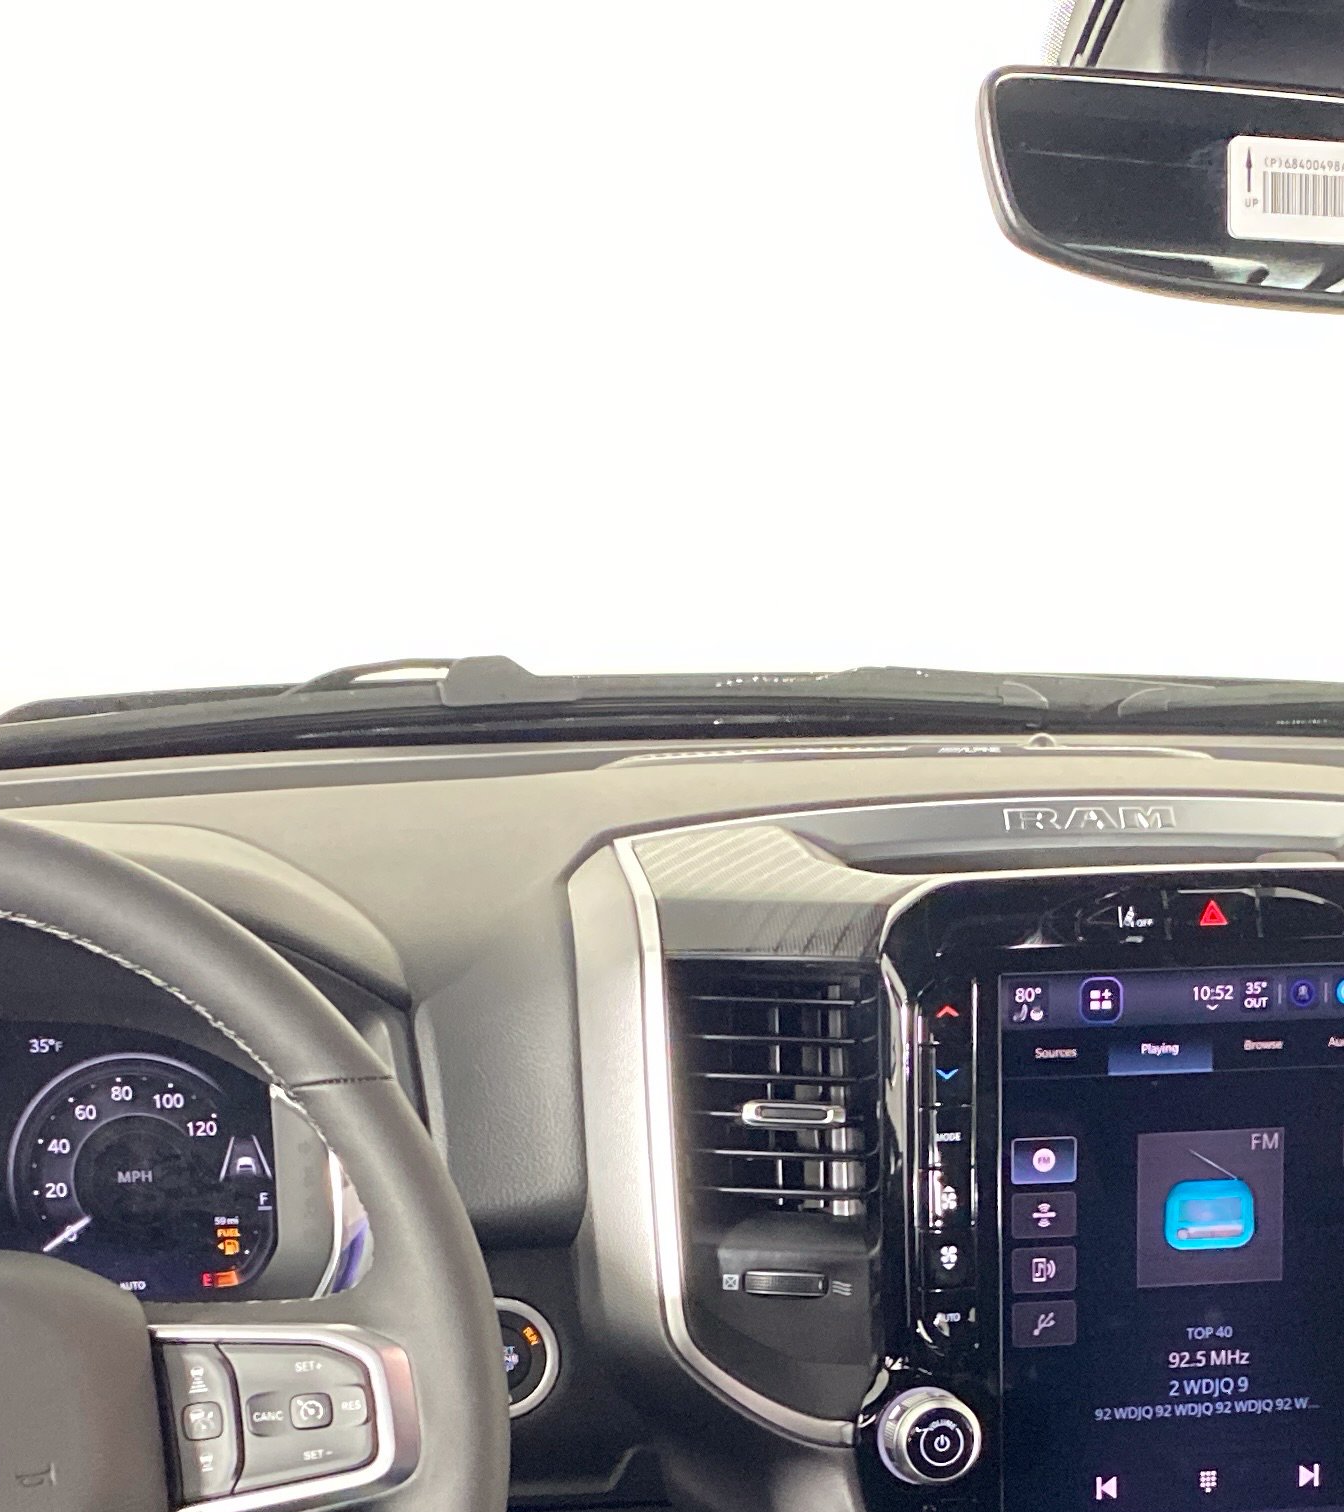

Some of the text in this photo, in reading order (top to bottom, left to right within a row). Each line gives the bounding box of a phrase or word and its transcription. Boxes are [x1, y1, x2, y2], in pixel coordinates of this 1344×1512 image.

[1245, 198, 1259, 208] UP
[1002, 806, 1177, 831] RAM
[1014, 987, 1042, 1002] 80°
[1192, 985, 1234, 1000] 10:52
[1244, 981, 1268, 994] 35°
[1244, 997, 1269, 1009] OUT
[1140, 1042, 1180, 1057] Playing
[1243, 1038, 1284, 1051] Browse
[1034, 1046, 1078, 1059] Sources
[111, 1086, 133, 1101] 80
[154, 1093, 185, 1109] 100
[75, 1105, 97, 1120] 60
[186, 1121, 217, 1137] 120
[47, 1139, 70, 1154] 40
[1251, 1133, 1279, 1150] FM
[117, 1170, 153, 1184] MPH
[45, 1183, 67, 1198] 20
[259, 1192, 268, 1205] F
[217, 1228, 241, 1237] FUEL
[202, 1272, 213, 1286] E
[1186, 1325, 1233, 1340] TOP 40
[1168, 1350, 1250, 1368] 92.5 MHz
[1169, 1377, 1249, 1398] 2 WDJQ 9
[341, 1399, 362, 1411] RES
[1095, 1407, 1112, 1421] 92
[1114, 1406, 1154, 1421] WDJQ
[1156, 1405, 1172, 1418] 92
[1174, 1403, 1213, 1418] WDJQ
[1215, 1401, 1232, 1415] 92
[1234, 1399, 1273, 1414] WDJQ
[1276, 1398, 1292, 1411] 92
[253, 1410, 284, 1422] CANC
